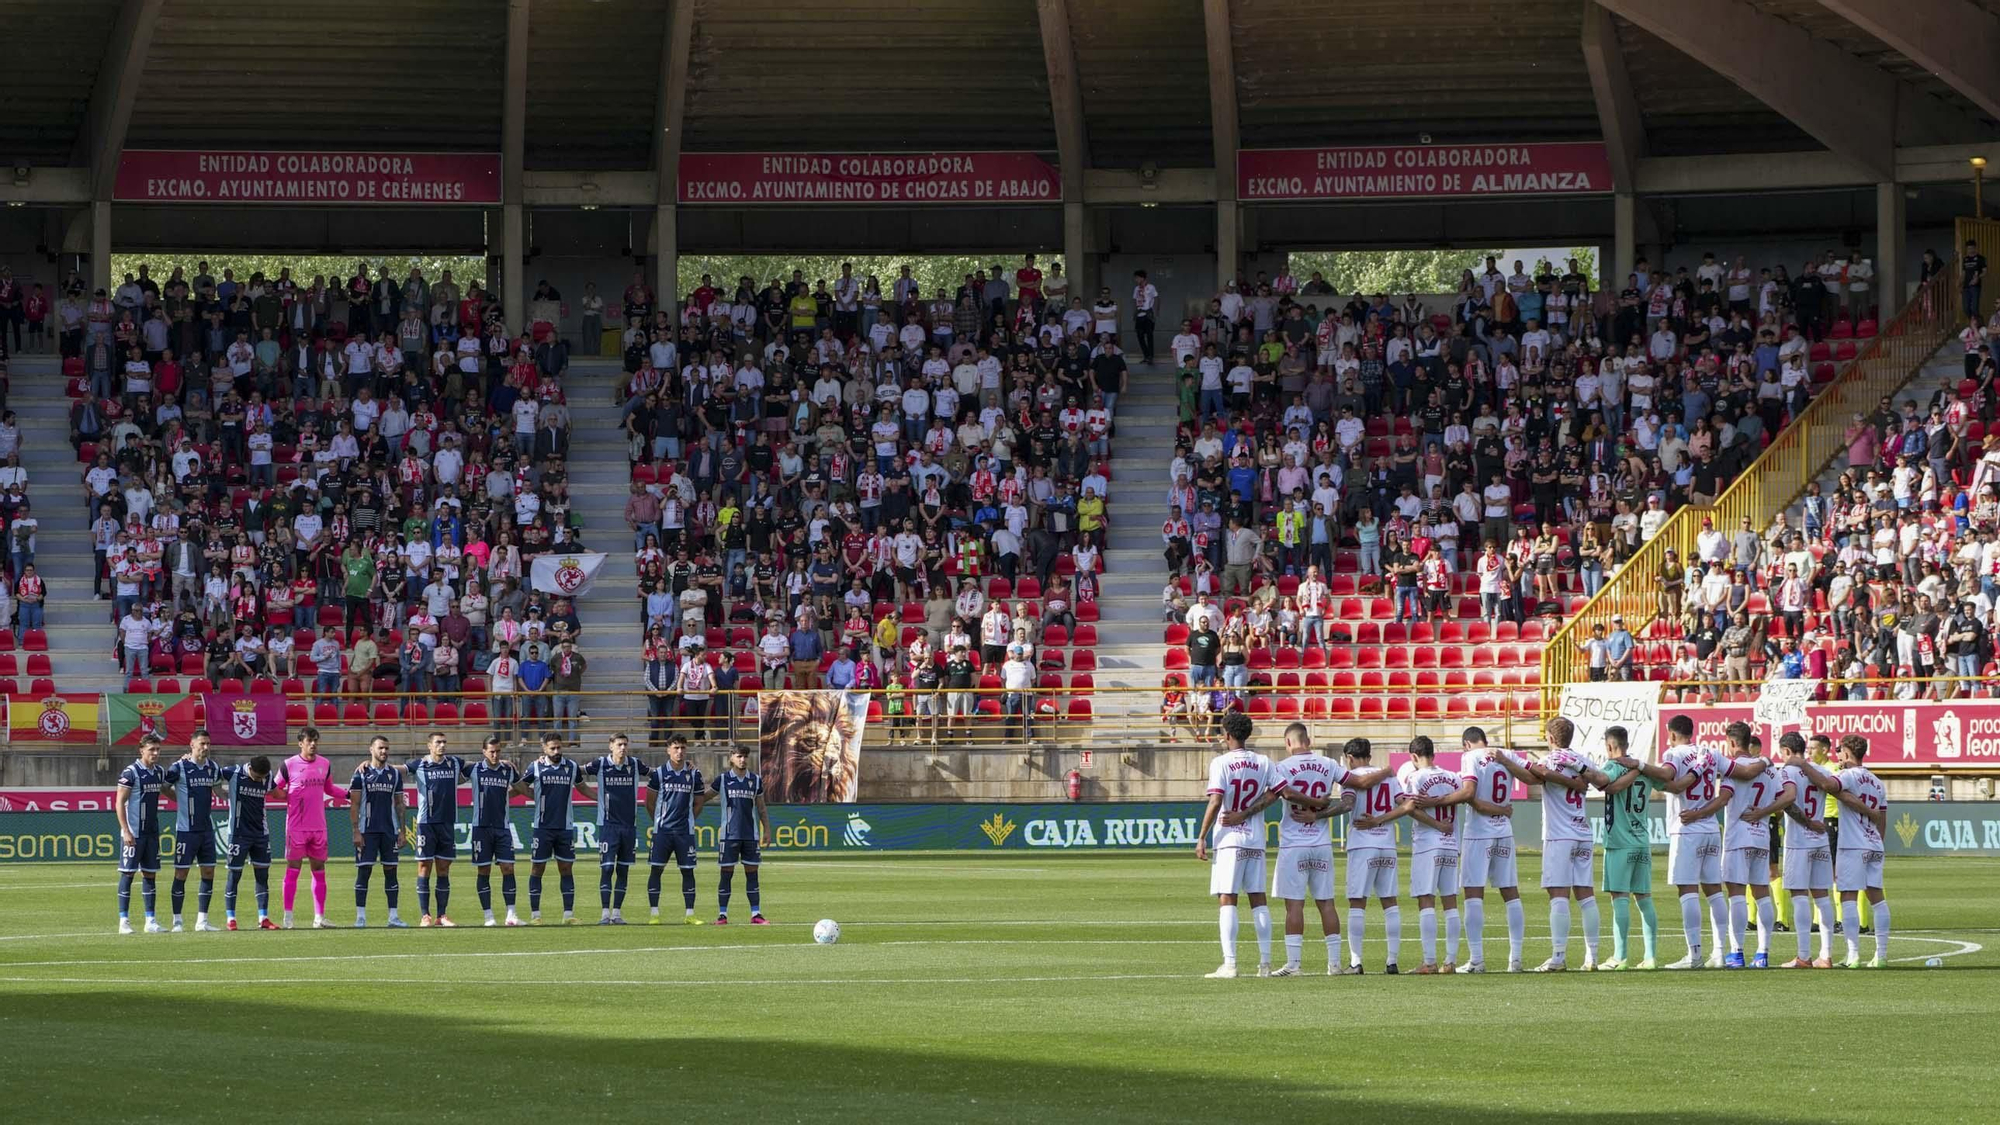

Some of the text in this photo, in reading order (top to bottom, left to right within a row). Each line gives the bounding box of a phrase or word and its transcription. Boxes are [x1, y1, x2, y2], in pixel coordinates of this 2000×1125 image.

[200, 155, 414, 175] ENTIDAD COLABORADORA
[763, 156, 974, 176] ENTIDAD COLABORADORA
[1318, 148, 1531, 169] ENTIDAD COLABORADORA
[148, 177, 462, 200] EXCMO. AYUNTAMIENTO DE CRÉMENES
[687, 179, 1051, 199] EXCMO. AYUNTAMIENTO DE CHOZAS DE ABAJO
[1248, 172, 1591, 195] EXCMO. AYUNTAMIENTO DE ALMANZA
[1562, 695, 1603, 718] ESTO
[1602, 699, 1623, 722] ES
[1698, 717, 1763, 740] prodos
[1815, 709, 1896, 733] DIPUTACIÓN
[1576, 722, 1593, 747] Y
[1229, 760, 1260, 772] HOMAM
[1230, 778, 1259, 812] 12
[1492, 770, 1507, 804] 6
[1624, 780, 1646, 814] 13
[1686, 769, 1715, 801] 28
[1751, 782, 1765, 809] 7
[1366, 782, 1392, 815] 14
[1804, 785, 1819, 818] 5
[1024, 818, 1201, 848] CAJA RURAL
[1924, 819, 2000, 851] CAJA R
[0, 834, 114, 859] somos
[123, 845, 136, 858] 20
[176, 842, 186, 855] 21
[228, 843, 240, 856] 23
